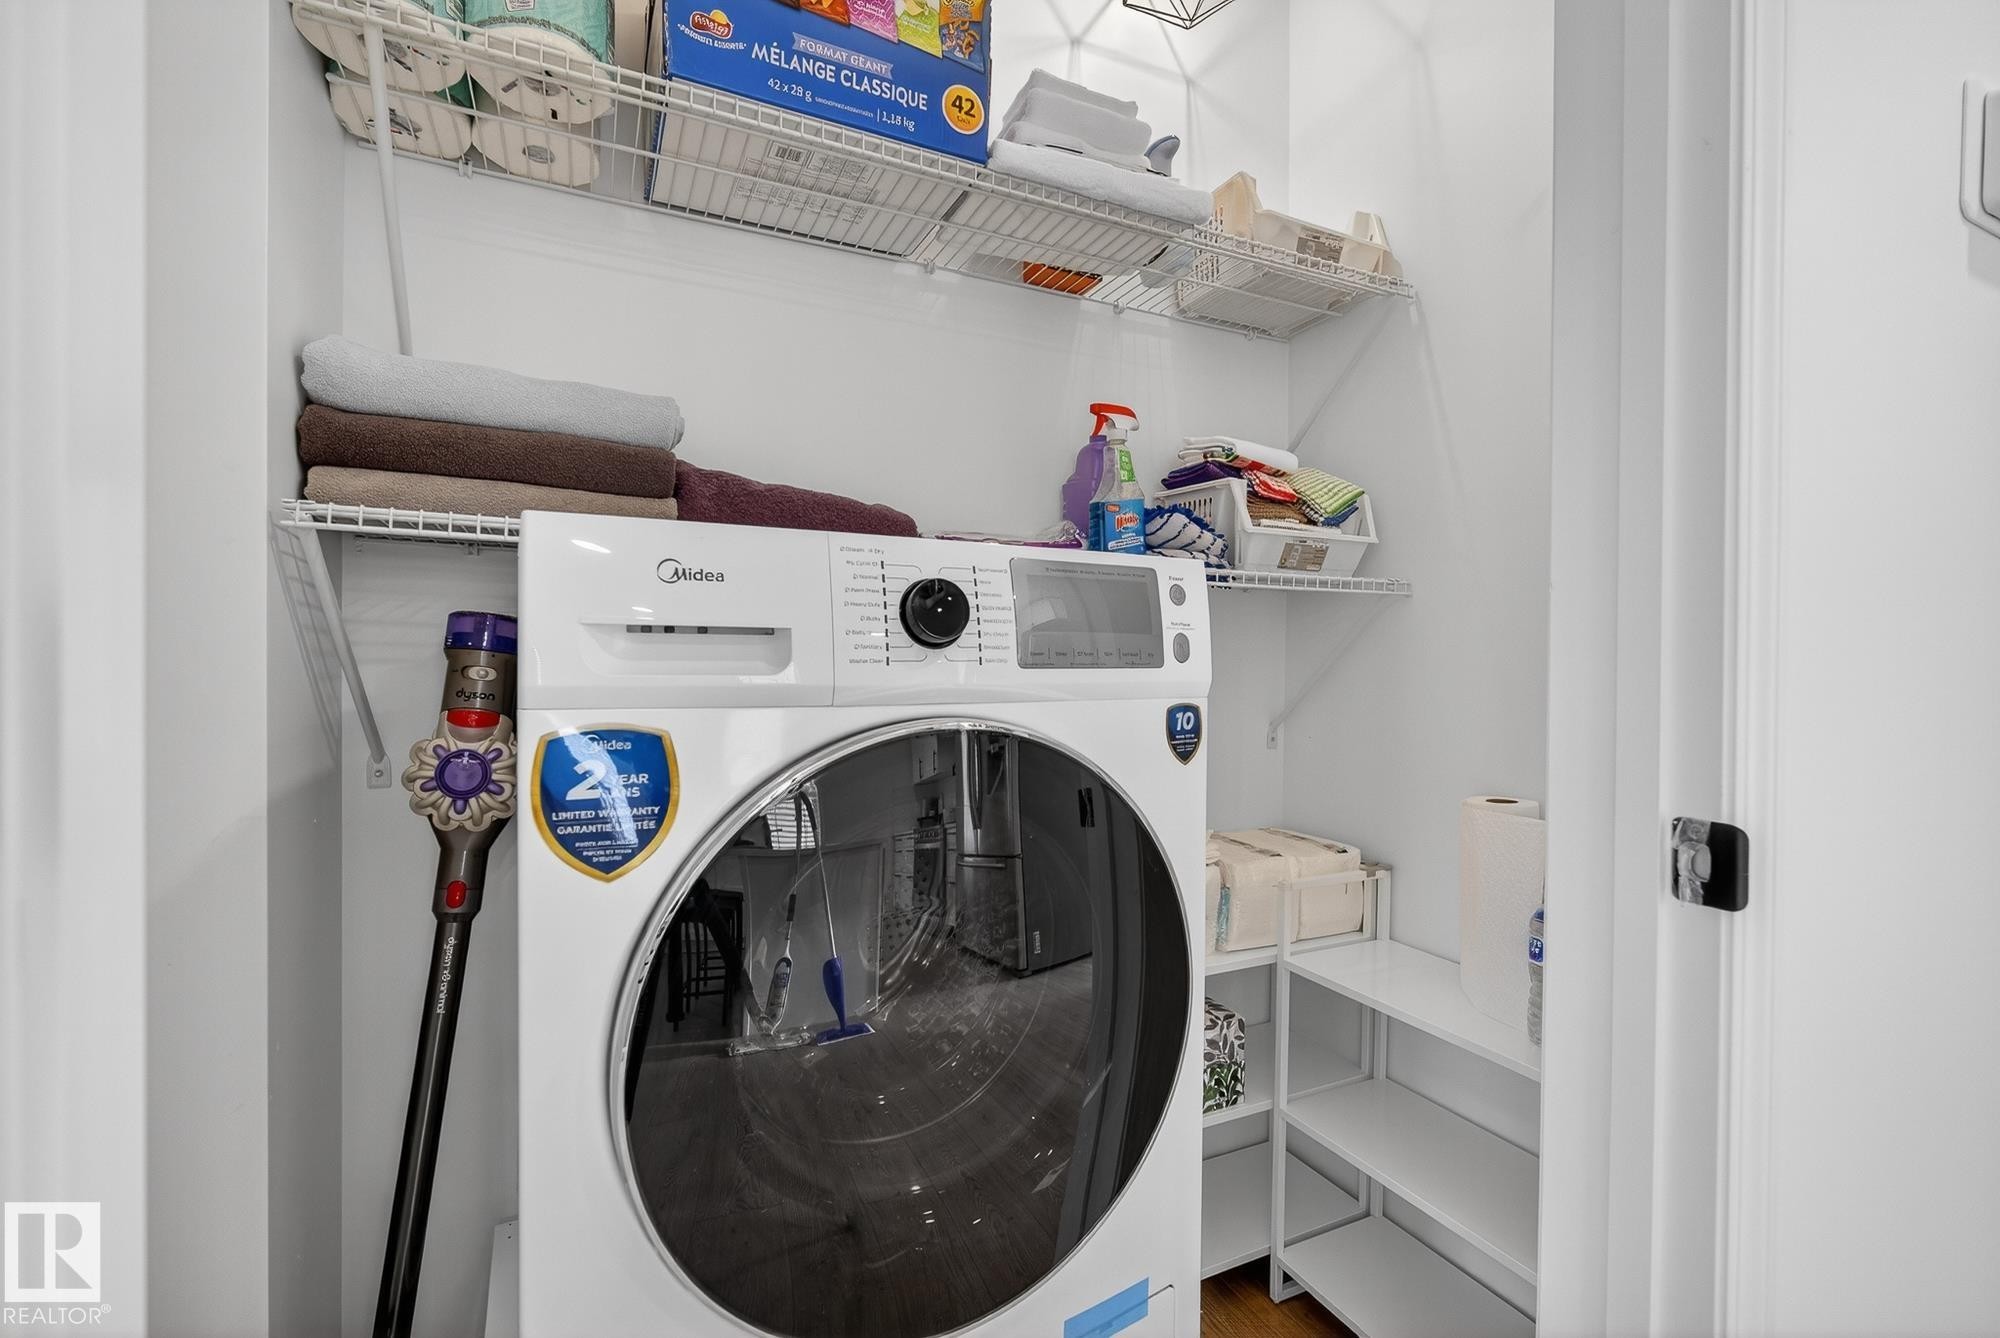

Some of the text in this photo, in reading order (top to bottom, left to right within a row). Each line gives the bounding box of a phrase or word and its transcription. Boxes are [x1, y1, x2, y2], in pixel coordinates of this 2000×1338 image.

[800, 39, 848, 62] FORMAT
[752, 42, 836, 83] MÉLANGE
[840, 70, 928, 111] CLASSIQUE
[768, 77, 781, 91] 42
[951, 95, 976, 118] 42
[656, 558, 725, 584] Midea
[455, 688, 496, 702] dyson
[1176, 711, 1195, 731] 10
[565, 759, 607, 801] 2
[615, 773, 649, 784] EAR
[552, 810, 595, 821] LIMITED
[557, 824, 612, 836] GARANTIE
